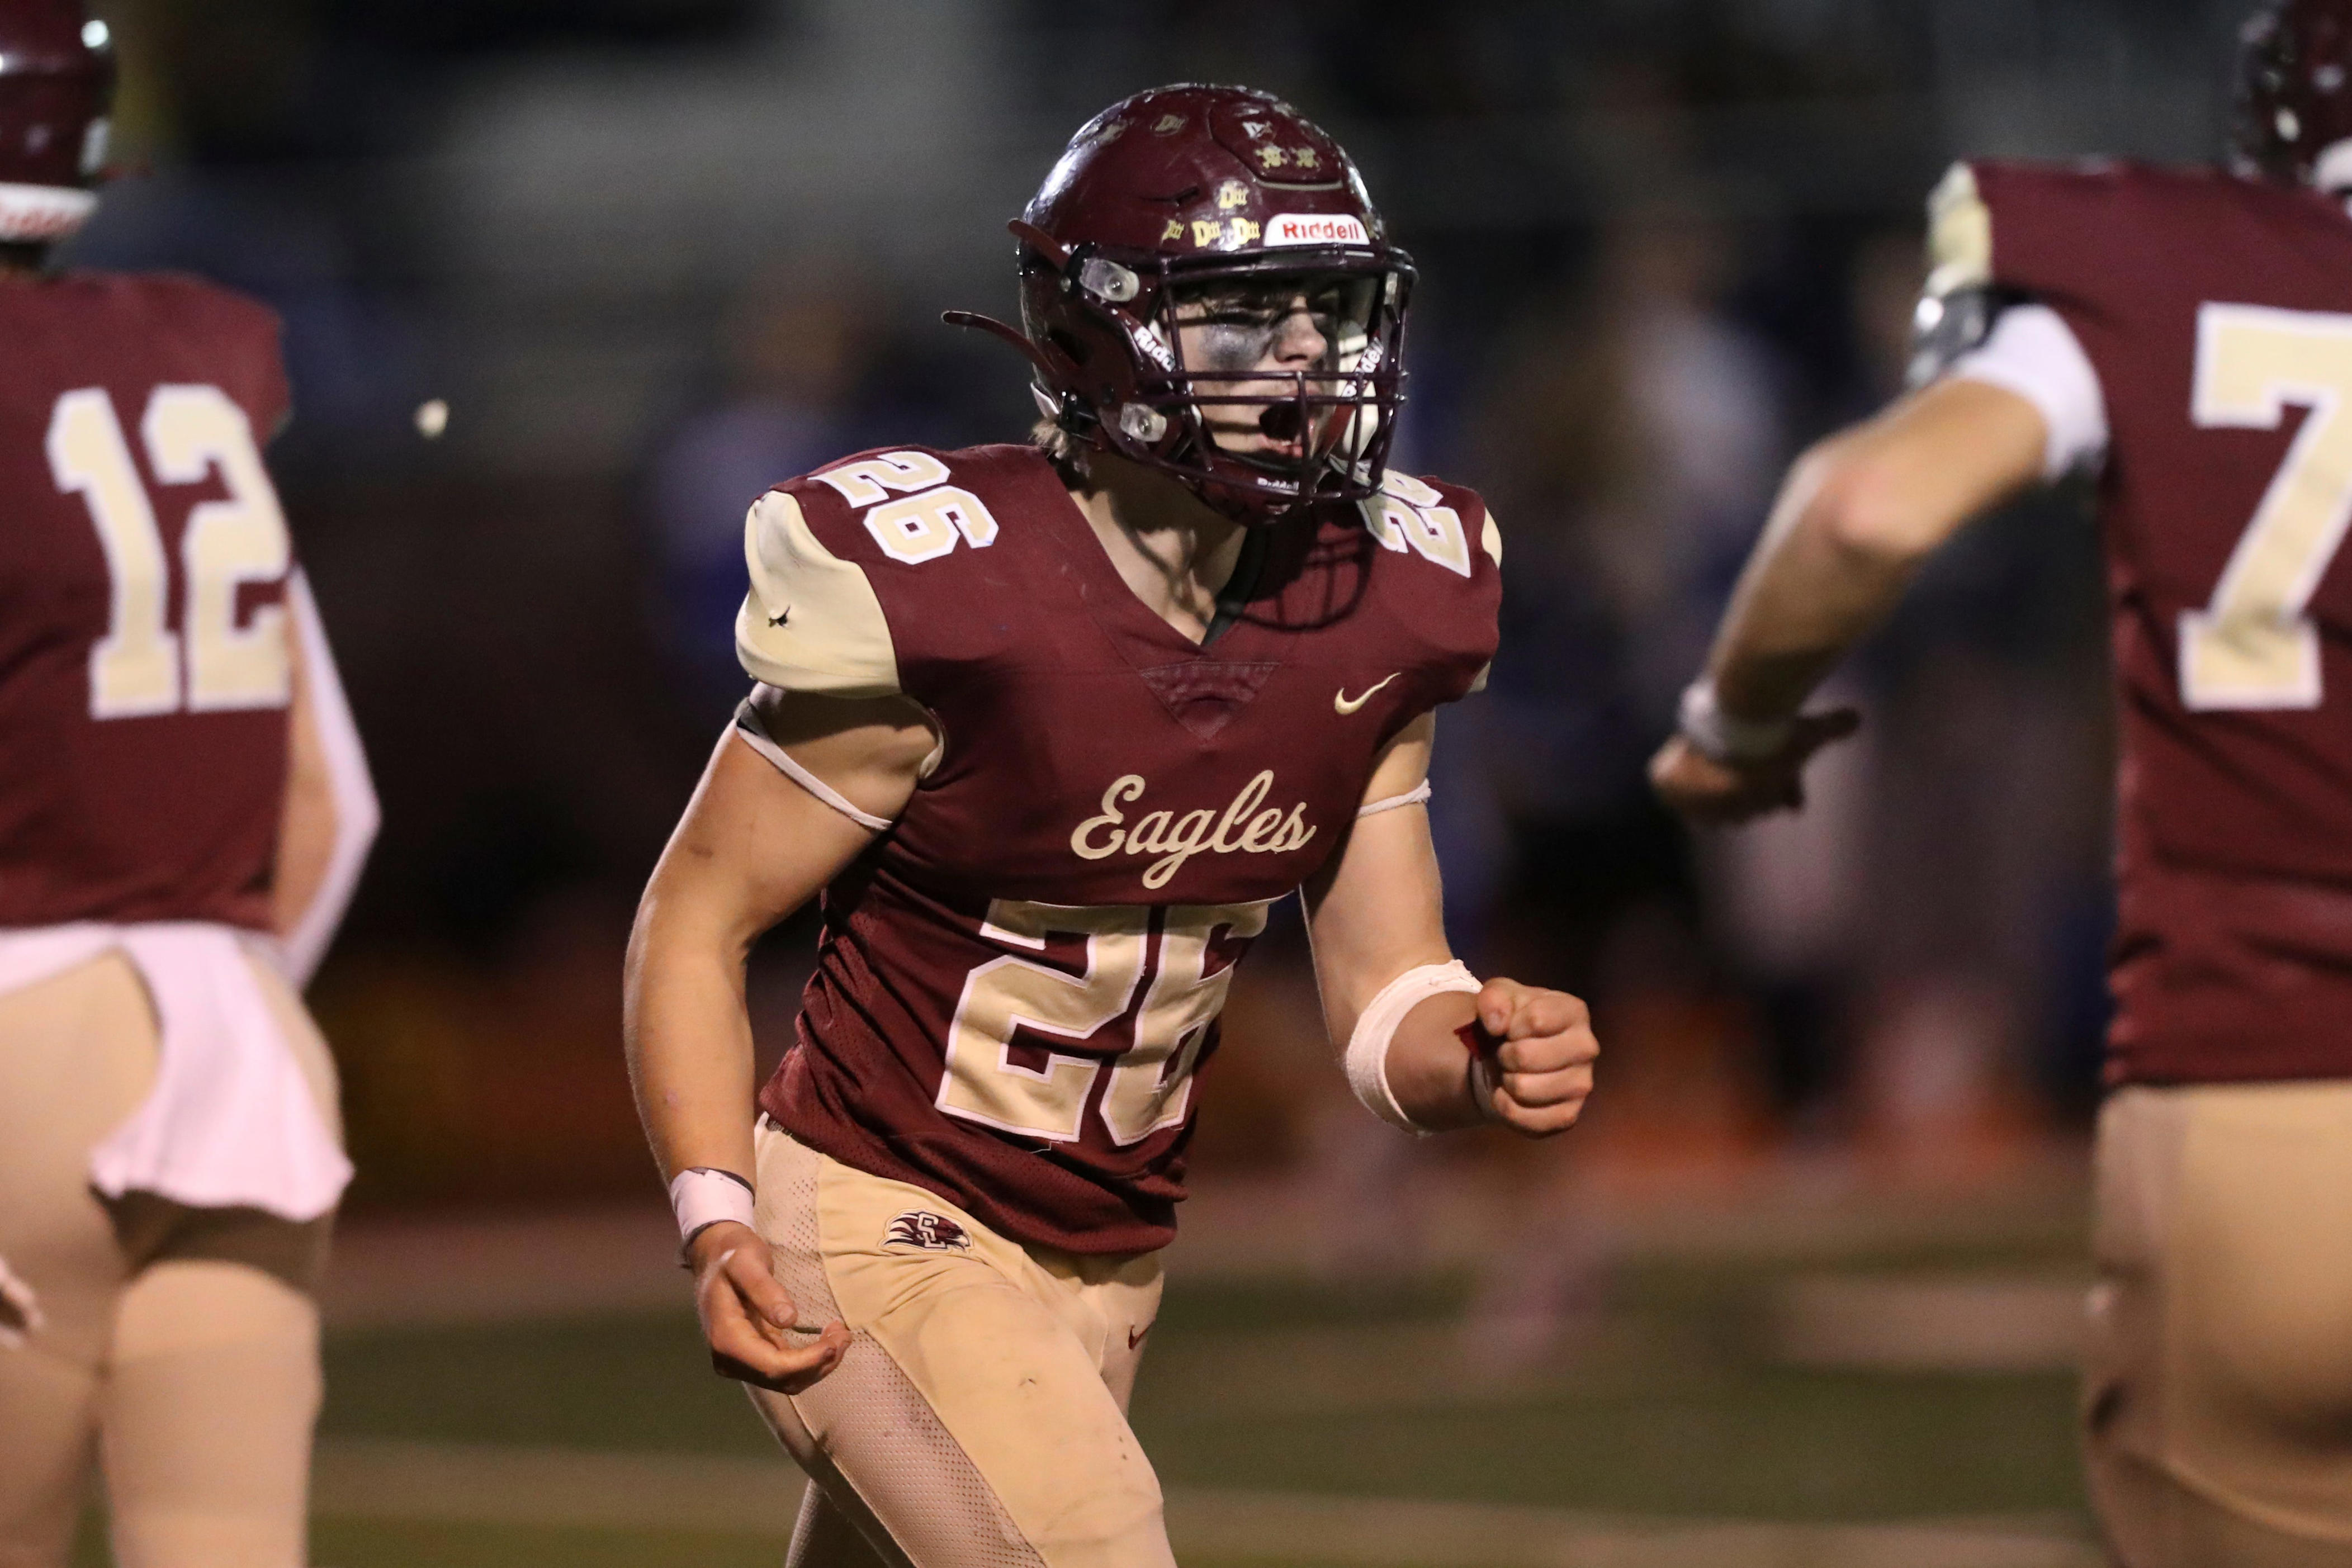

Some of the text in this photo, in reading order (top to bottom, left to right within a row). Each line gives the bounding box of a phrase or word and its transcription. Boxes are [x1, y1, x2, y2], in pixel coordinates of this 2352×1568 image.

[1283, 221, 1360, 239] Riddell
[1133, 326, 1176, 372] Ridd
[46, 383, 293, 721] 12
[807, 451, 999, 565] 26
[2178, 301, 2352, 712] 7
[1070, 769, 1317, 890] Eagles
[935, 898, 1269, 1147] 26
